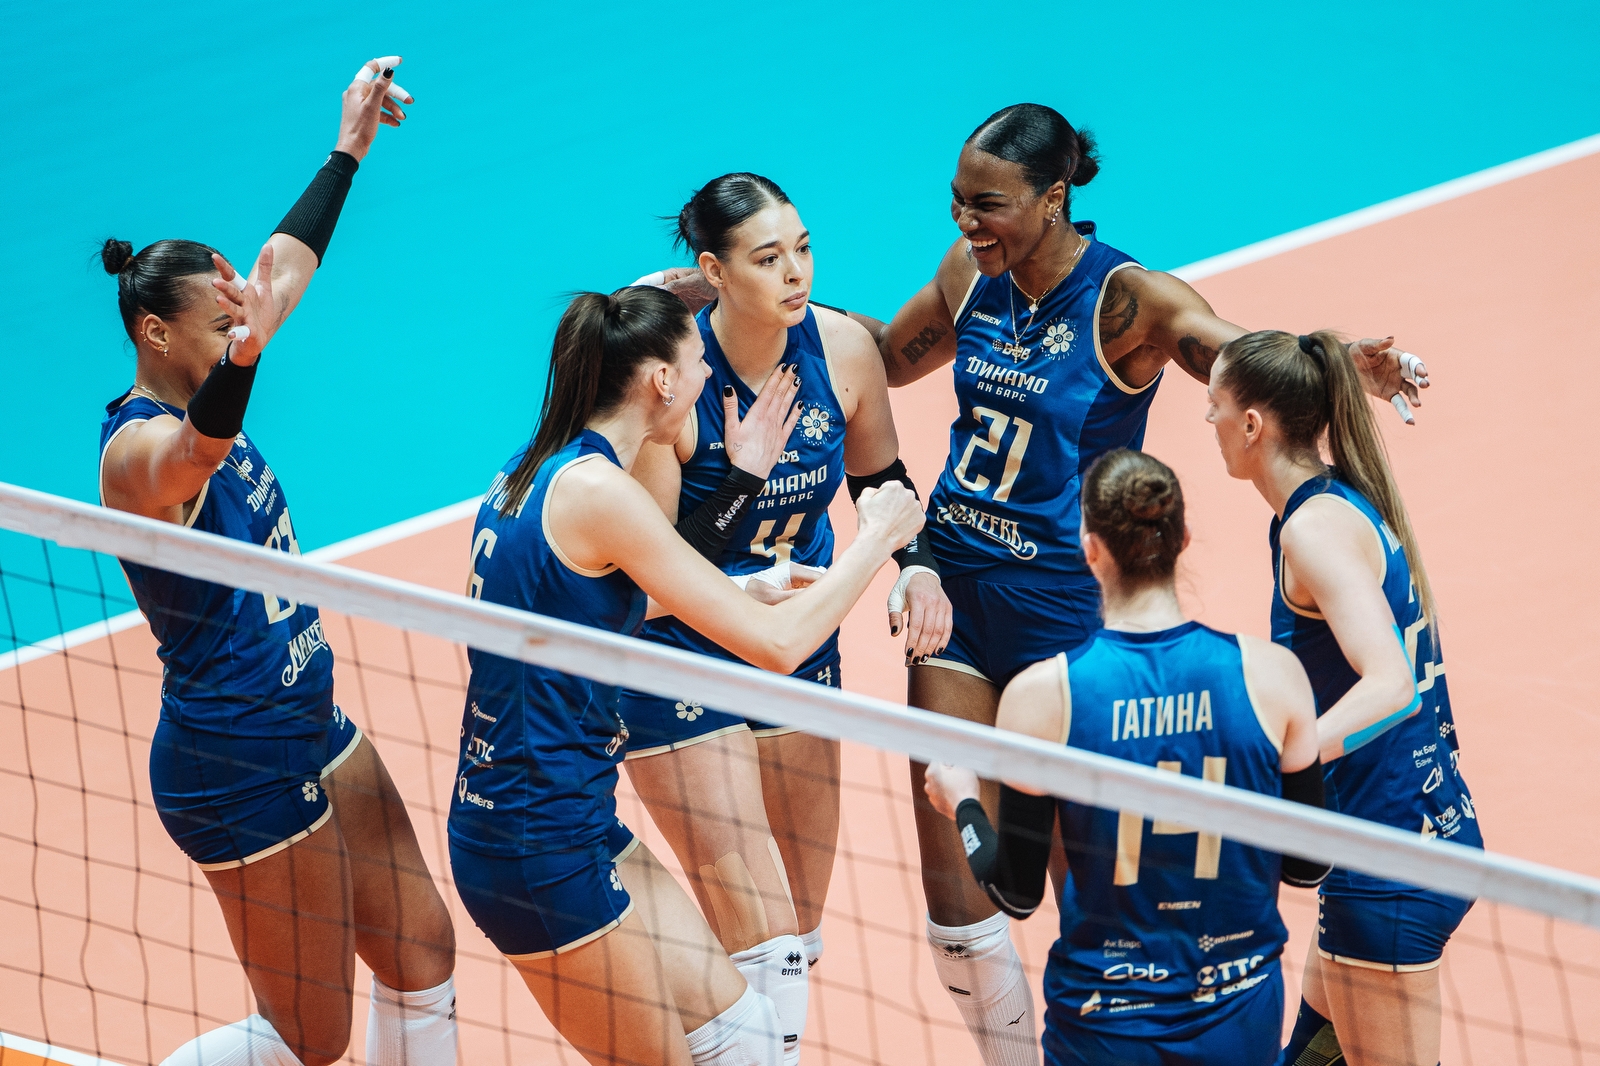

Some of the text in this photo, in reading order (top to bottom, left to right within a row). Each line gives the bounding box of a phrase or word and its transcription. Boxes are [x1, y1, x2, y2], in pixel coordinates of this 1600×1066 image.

[966, 355, 1049, 394] ДИНАМО
[995, 386, 1027, 402] БАРС
[954, 406, 1033, 502] 21
[780, 490, 814, 506] БАРС
[750, 513, 806, 566] 4
[1112, 689, 1213, 742] ГАТИНА
[466, 791, 494, 810] sollers
[1113, 756, 1227, 886] 14
